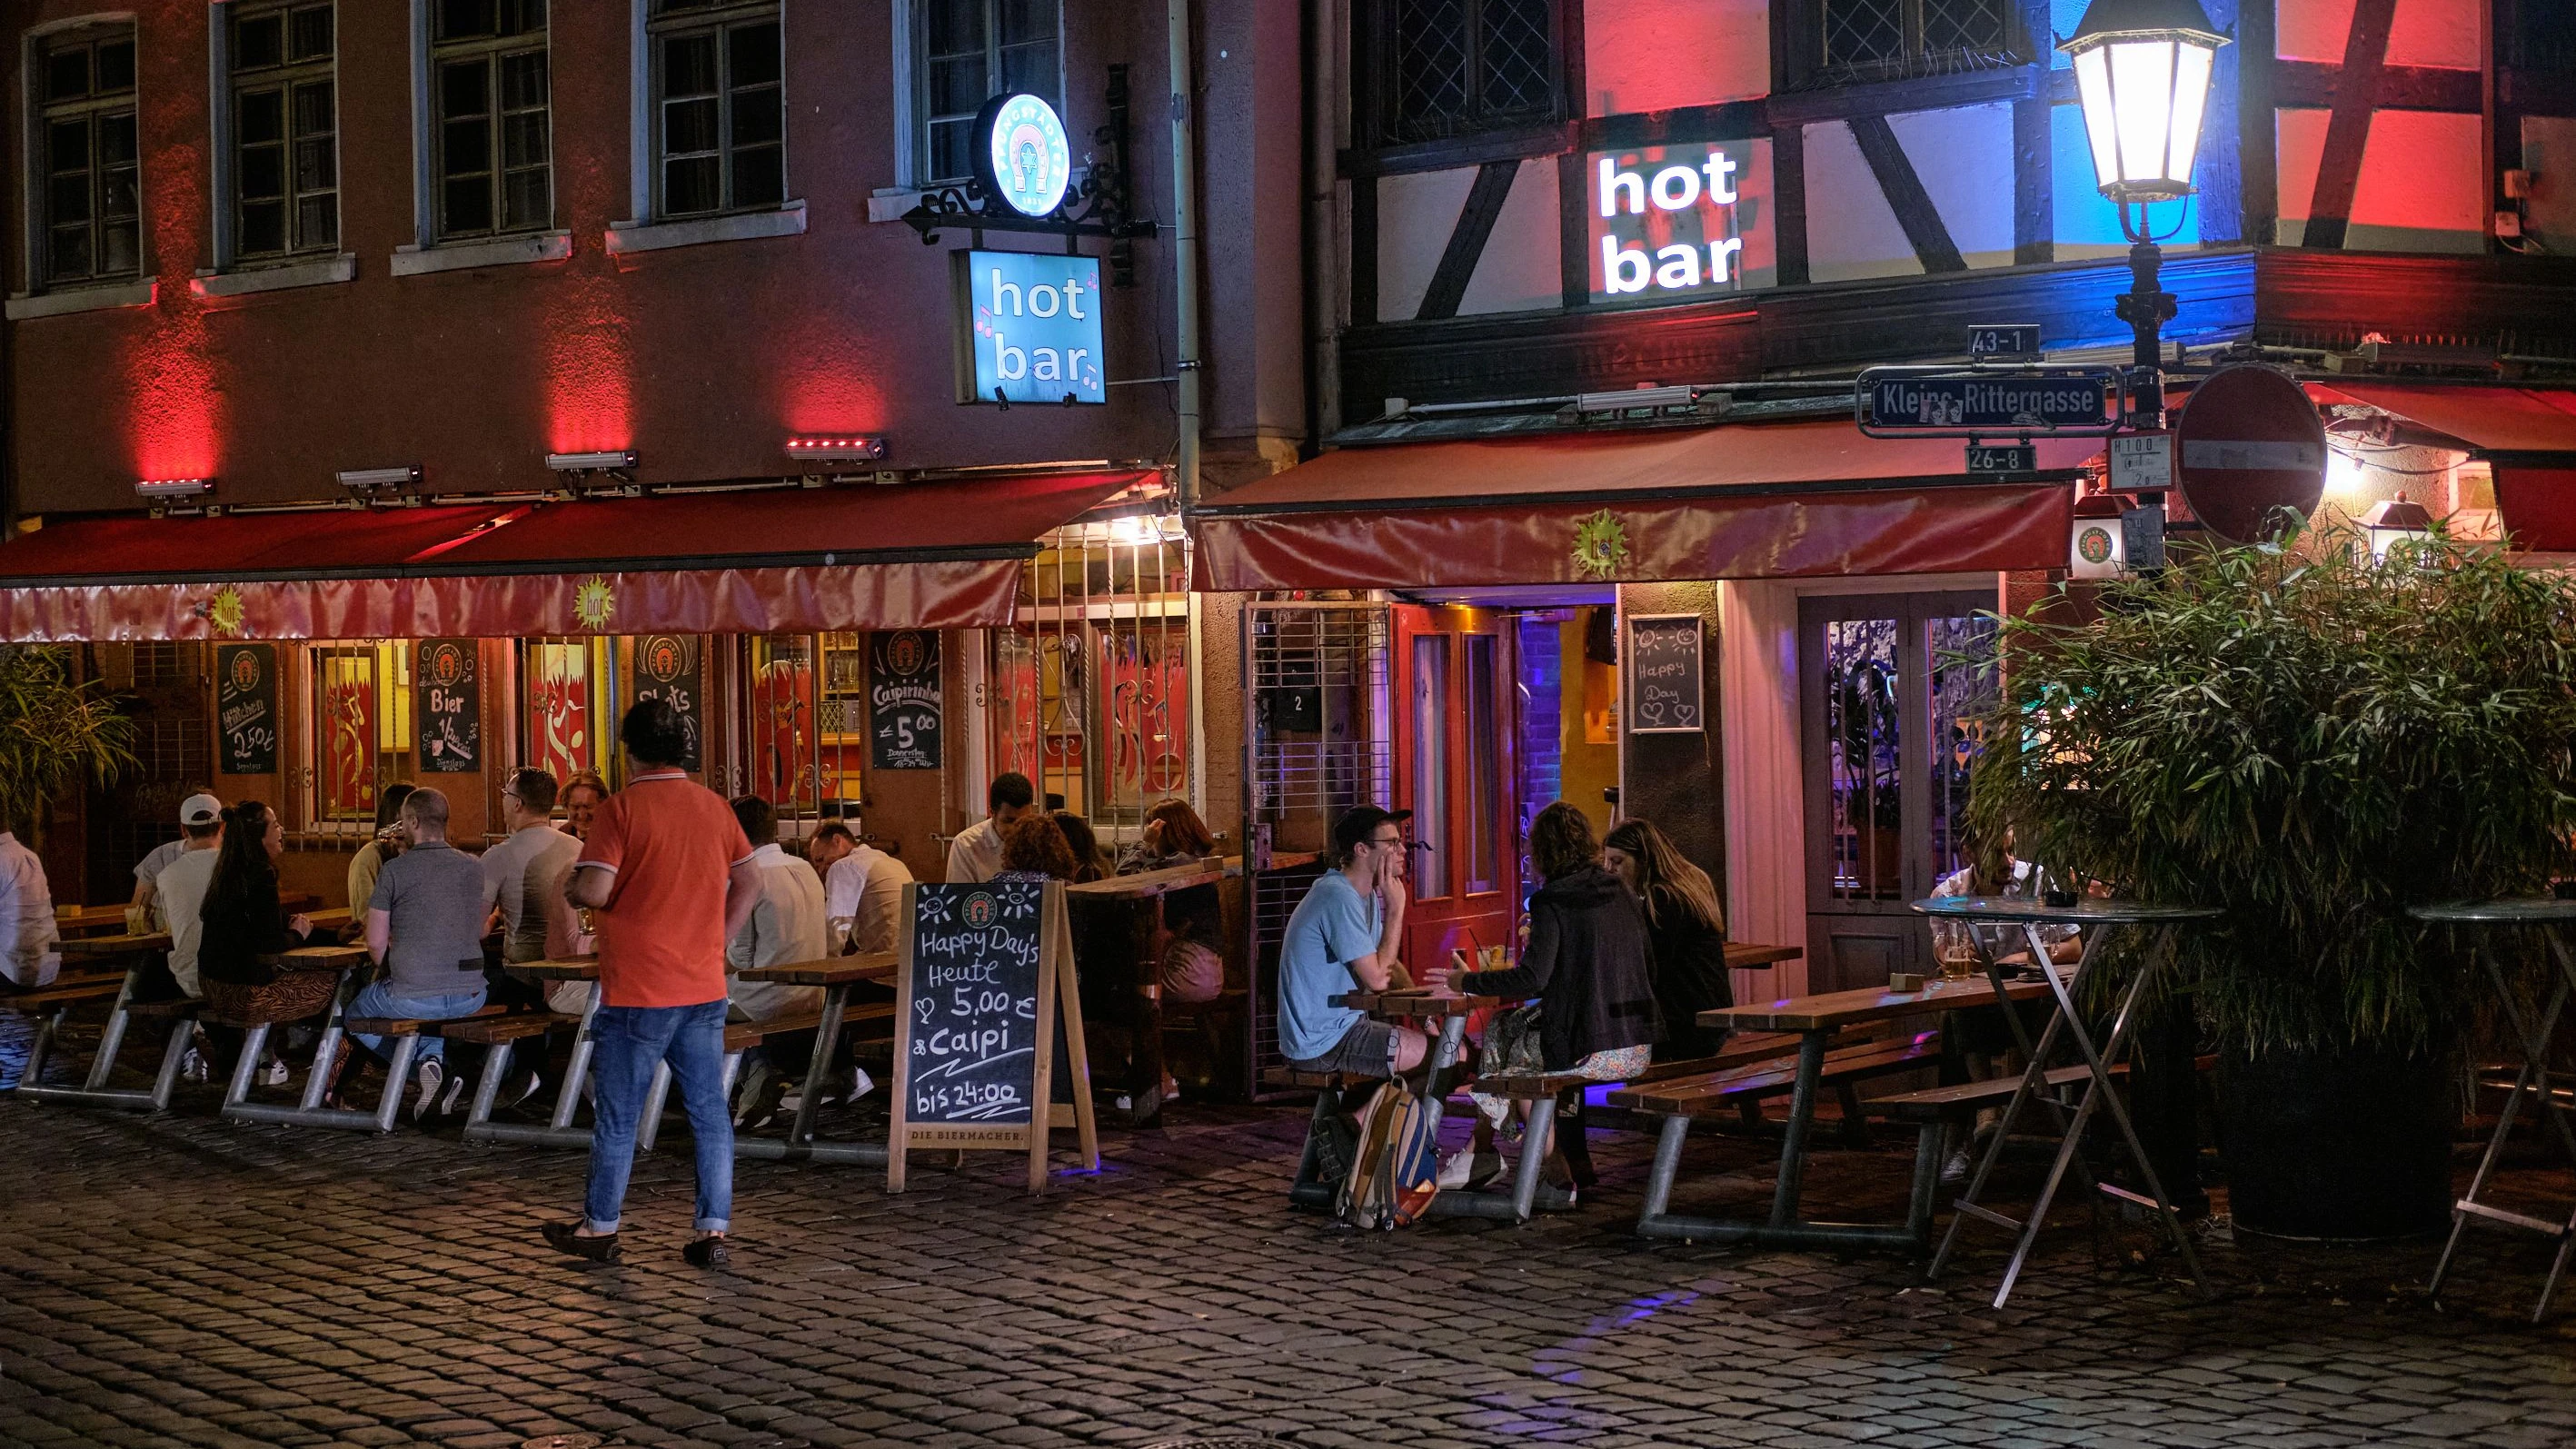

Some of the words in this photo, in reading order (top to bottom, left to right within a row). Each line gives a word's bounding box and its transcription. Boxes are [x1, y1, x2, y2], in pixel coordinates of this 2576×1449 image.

[1599, 153, 1737, 217] hot
[1602, 235, 1742, 294] bar
[992, 268, 1085, 320] hot
[1973, 331, 2021, 352] 43-1
[996, 332, 1087, 382] bar
[1964, 383, 2094, 418] Rittergasse
[1970, 450, 2019, 469] 26-8
[1591, 530, 1613, 560] ht
[1638, 662, 1686, 680] Happy
[431, 688, 464, 713] Bier
[873, 679, 940, 708] Caipirinha
[1294, 695, 1302, 711] 2
[1645, 685, 1679, 704] Day
[921, 928, 986, 958] Happy
[929, 958, 1001, 988] Heute
[950, 987, 1010, 1017] 5,00
[930, 1019, 1009, 1059] Caipi
[916, 1085, 949, 1115] bis
[953, 1079, 1016, 1106] 24:00
[911, 1131, 932, 1139] DIE
